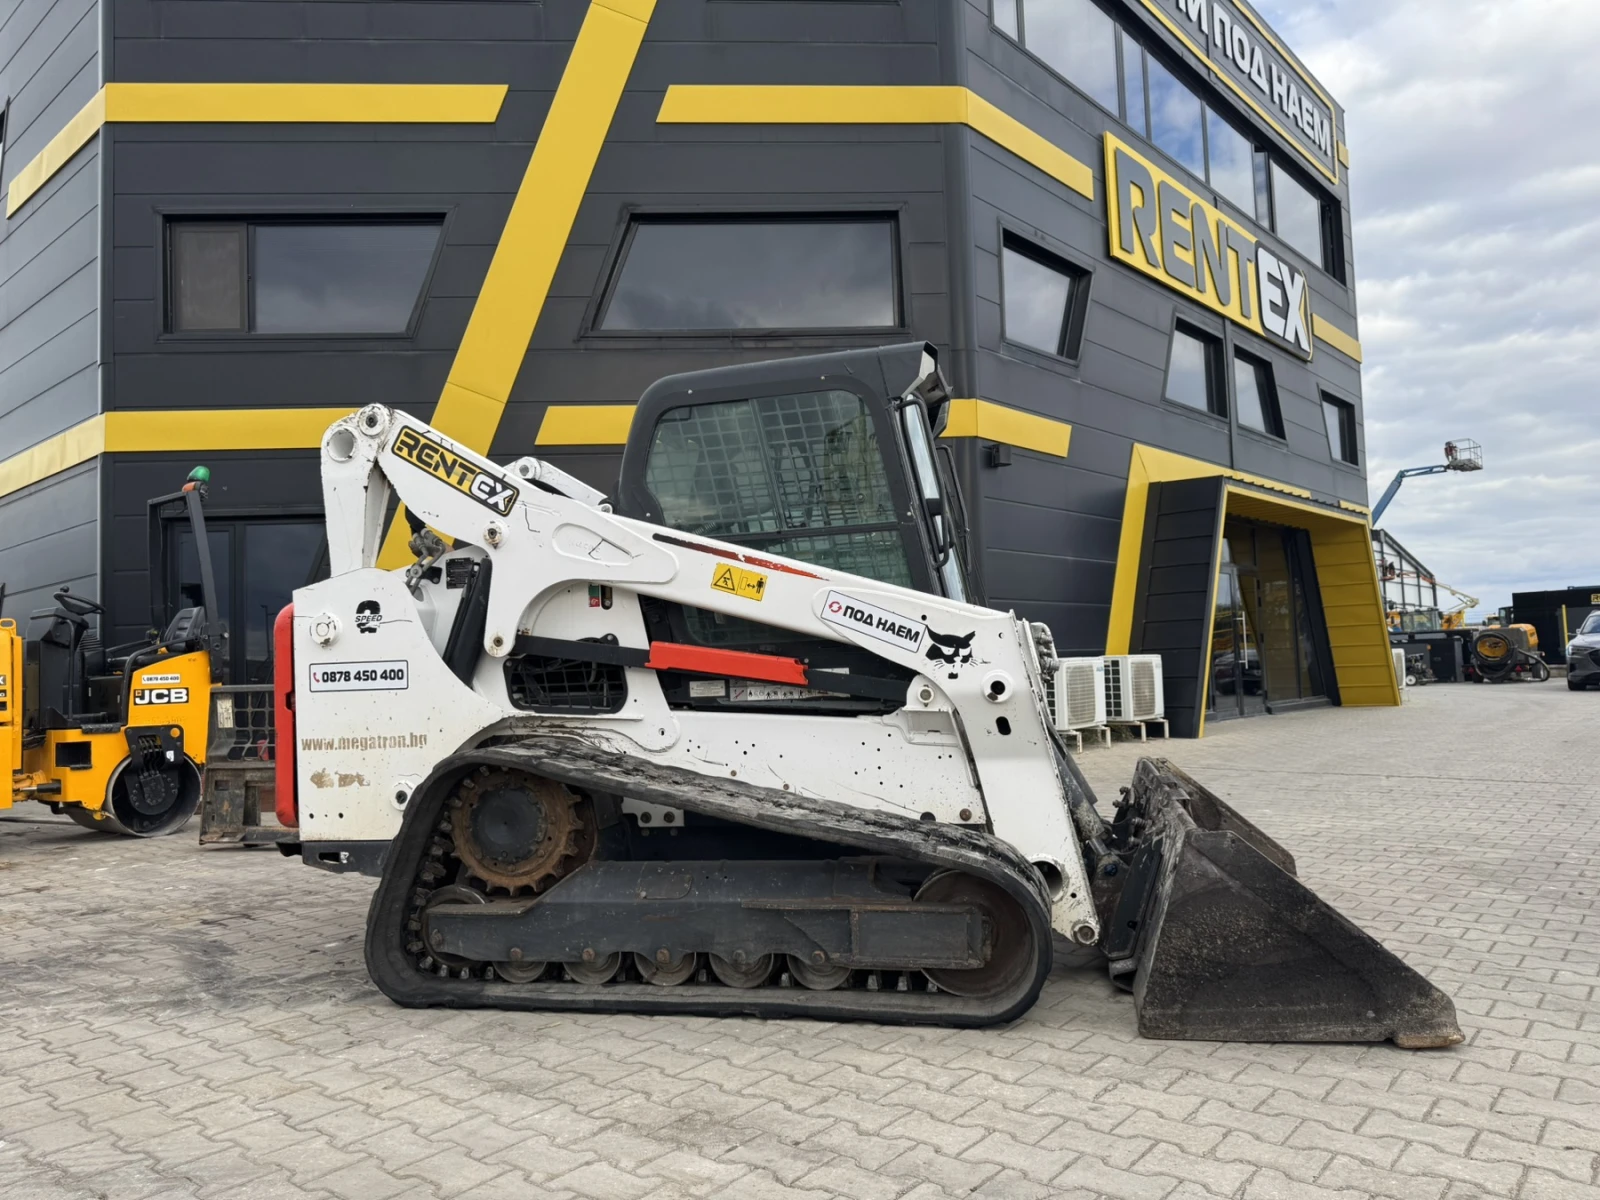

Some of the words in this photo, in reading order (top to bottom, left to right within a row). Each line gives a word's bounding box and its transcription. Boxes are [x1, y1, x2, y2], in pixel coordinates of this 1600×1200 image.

[1213, 2, 1269, 95] ПОД
[1271, 62, 1331, 157] НАЕМ
[1115, 146, 1311, 353] RENTEX
[396, 430, 514, 512] RENTEX
[843, 605, 873, 627] ПОД
[876, 617, 920, 643] НАЕМ
[135, 688, 188, 704] JCB
[322, 671, 351, 683] 0878
[353, 670, 378, 681] 450
[380, 669, 404, 681] 400
